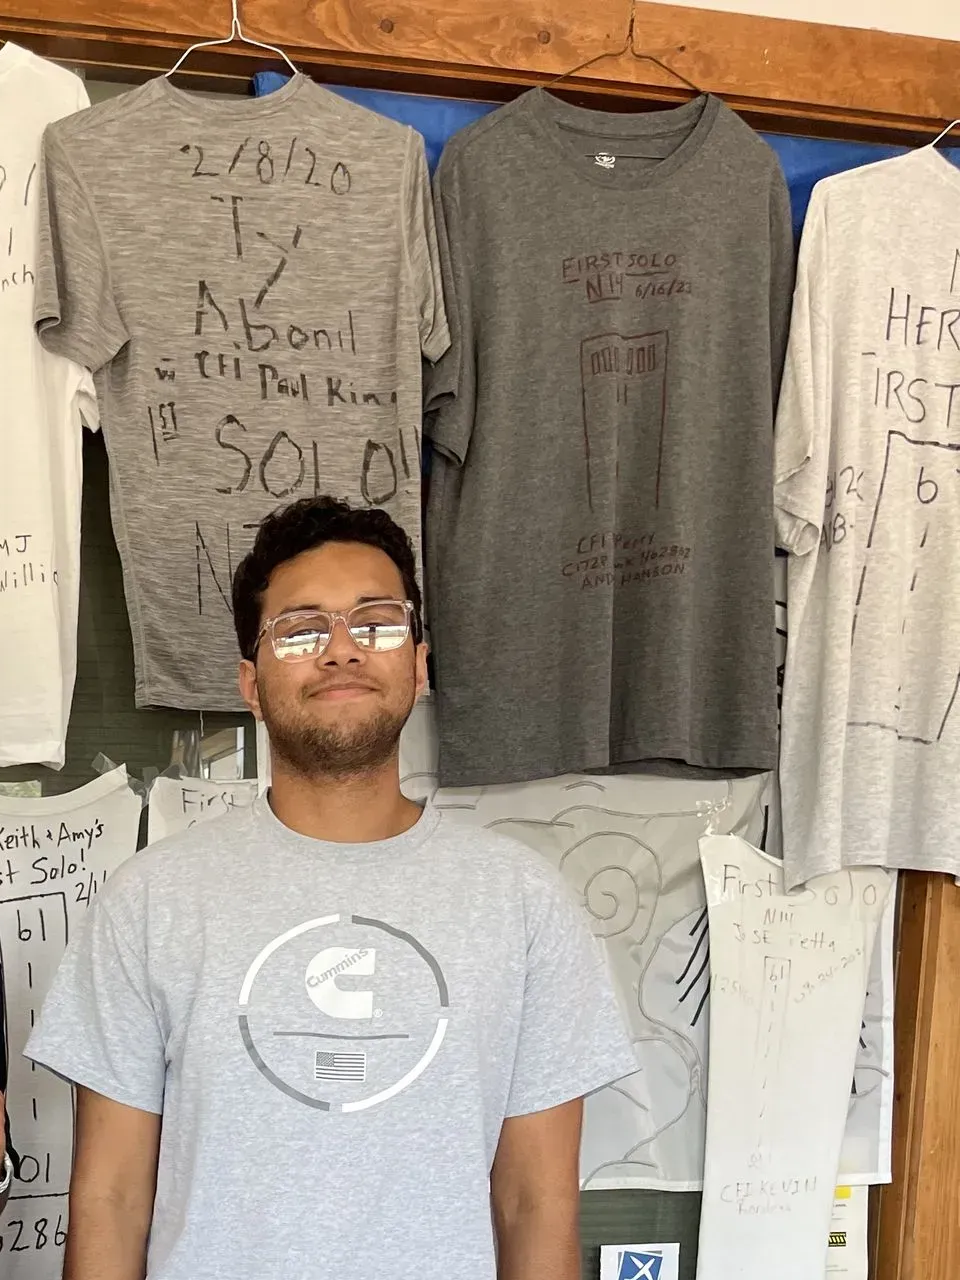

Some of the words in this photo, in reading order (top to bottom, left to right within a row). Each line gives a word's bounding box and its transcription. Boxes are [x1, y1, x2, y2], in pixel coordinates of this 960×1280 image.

[179, 136, 351, 195] 2/8/20
[562, 252, 623, 279] FIRST
[627, 253, 677, 268] SOLO
[586, 273, 624, 298] N14
[258, 364, 309, 401] Paul
[577, 534, 606, 555] CFI
[181, 787, 246, 814] First
[57, 819, 105, 849] Amy's
[30, 848, 86, 885] Solo!
[723, 864, 780, 897] First
[17, 909, 46, 941] 61
[306, 948, 368, 989] Cummins
[19, 1152, 51, 1183] 01
